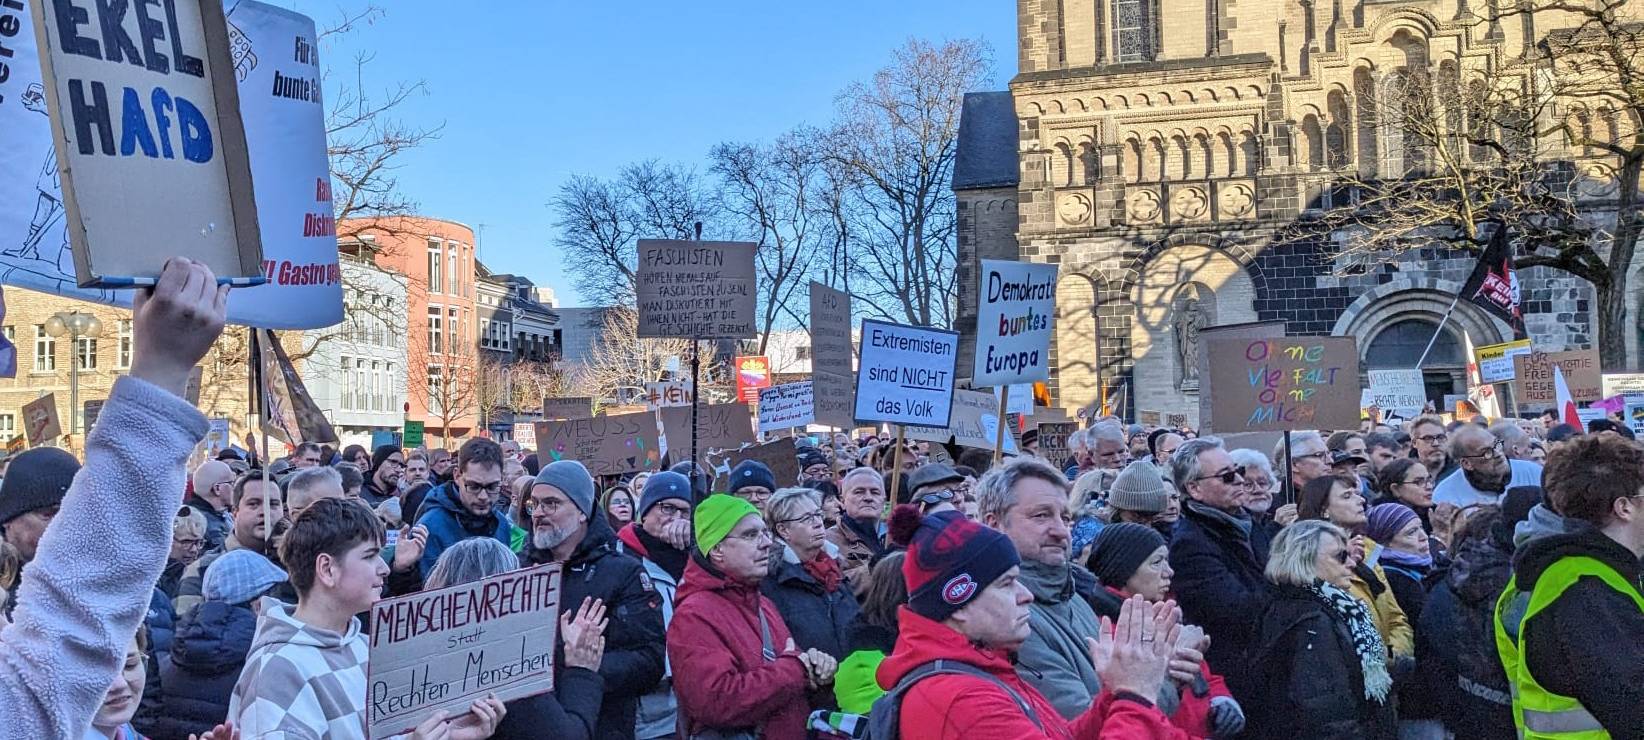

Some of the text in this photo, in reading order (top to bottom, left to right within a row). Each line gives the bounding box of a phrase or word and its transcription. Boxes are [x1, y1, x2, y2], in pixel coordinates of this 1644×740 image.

[52, 0, 205, 78] EKEL
[295, 36, 309, 64] Für
[272, 70, 309, 101] bunte
[646, 248, 724, 267] FASCHISTEN
[278, 261, 325, 286] Gastro
[659, 284, 714, 297] FASCHISTEN
[641, 301, 662, 313] MAN
[666, 298, 714, 311] DISKUTIERT
[671, 311, 696, 324] NICHT
[721, 310, 736, 320] DIE
[660, 322, 715, 336] GESCHICHTE
[999, 306, 1047, 336] buntes
[872, 329, 951, 355] Extremisten
[986, 345, 1038, 375] Europa
[1481, 351, 1504, 359] Kinder
[1523, 351, 1548, 363] FÜR
[1524, 358, 1592, 371] DEMOKRATIE
[869, 364, 947, 388] sind NICHT
[1525, 381, 1553, 391] GEGE
[876, 396, 901, 415] das
[906, 398, 933, 418] Volk
[554, 416, 640, 440] NEUSS
[373, 570, 560, 647] MENSCHENRECHTE
[372, 636, 553, 720] Rechten Menschen
